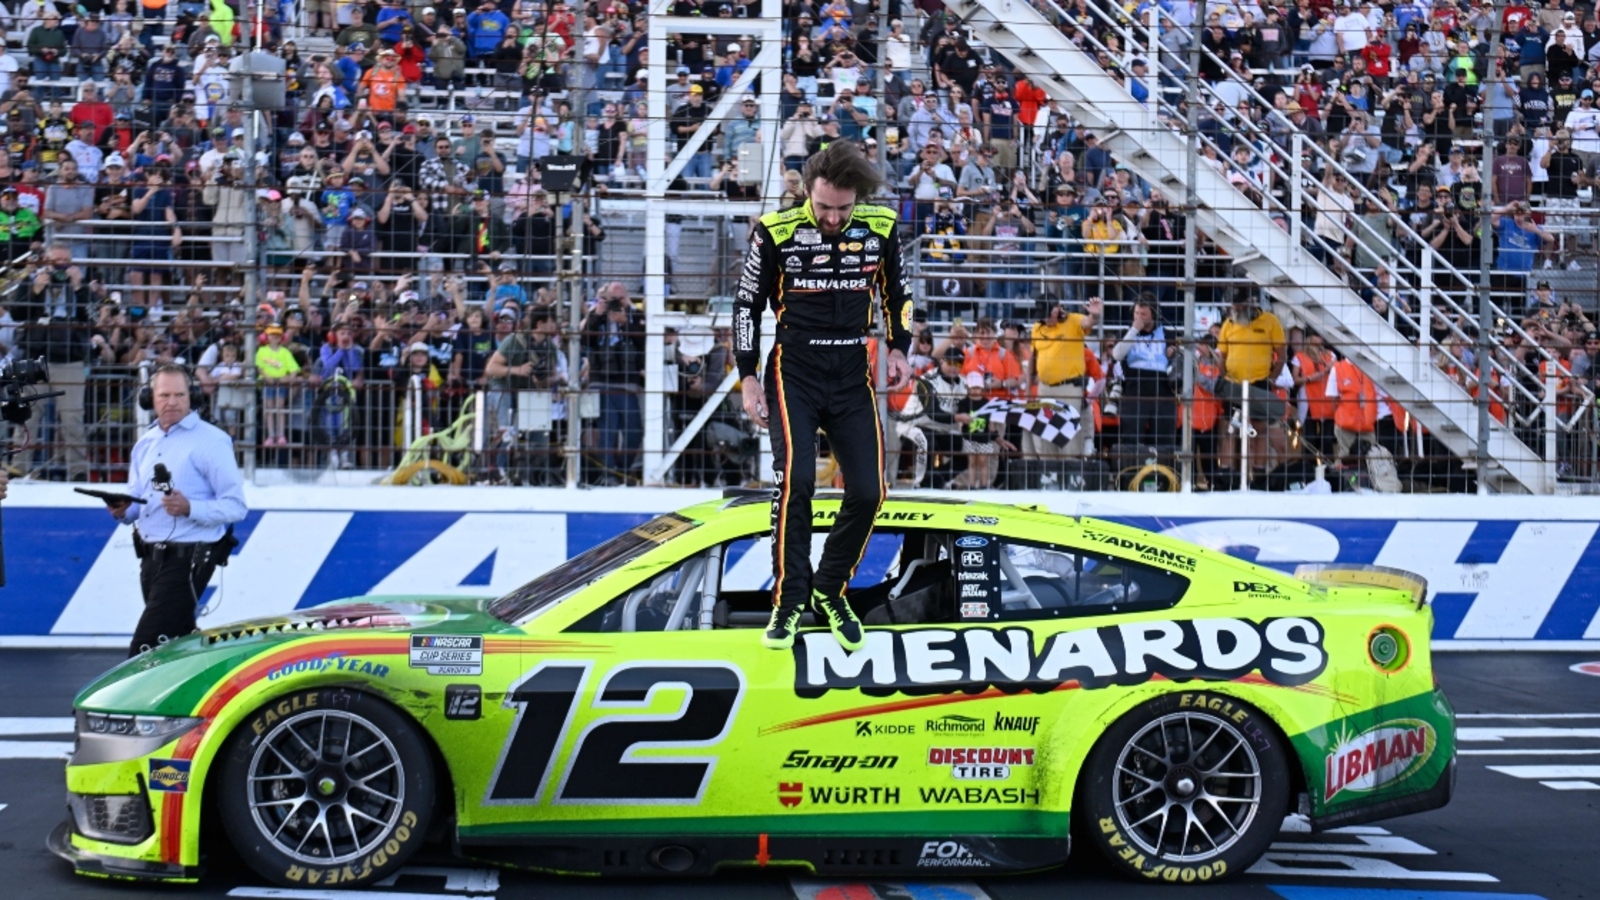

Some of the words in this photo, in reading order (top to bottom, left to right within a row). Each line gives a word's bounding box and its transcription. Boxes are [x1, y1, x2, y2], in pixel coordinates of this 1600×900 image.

[793, 277, 867, 290] MENARDS
[962, 552, 983, 565] PPG
[1108, 536, 1197, 567] ADVANCE
[1140, 553, 1166, 564] AUTO
[1166, 560, 1196, 573] PARTS
[1233, 580, 1280, 594] DEX
[434, 637, 473, 648] NASCAR
[803, 616, 1320, 685] MENARDS
[267, 652, 390, 681] GOODYEAR
[420, 651, 440, 661] CUP
[440, 651, 473, 661] SERIES
[447, 688, 481, 716] 12
[1179, 693, 1250, 724] EAGLE
[251, 692, 319, 736] EAGLE
[994, 711, 1041, 736] KNAUF
[481, 659, 747, 806] 12
[875, 724, 916, 735] KIDDE
[926, 718, 986, 733] Richmond
[781, 749, 900, 773] Snap-on
[928, 747, 1035, 766] DISCOUNT
[1324, 726, 1426, 803] LIBMAN
[151, 769, 189, 783] SUNOCO
[958, 766, 1004, 778] TIRE
[920, 787, 1040, 805] WABASH
[285, 810, 418, 884] GOODYEAR
[1098, 816, 1227, 883] GOODYEAR
